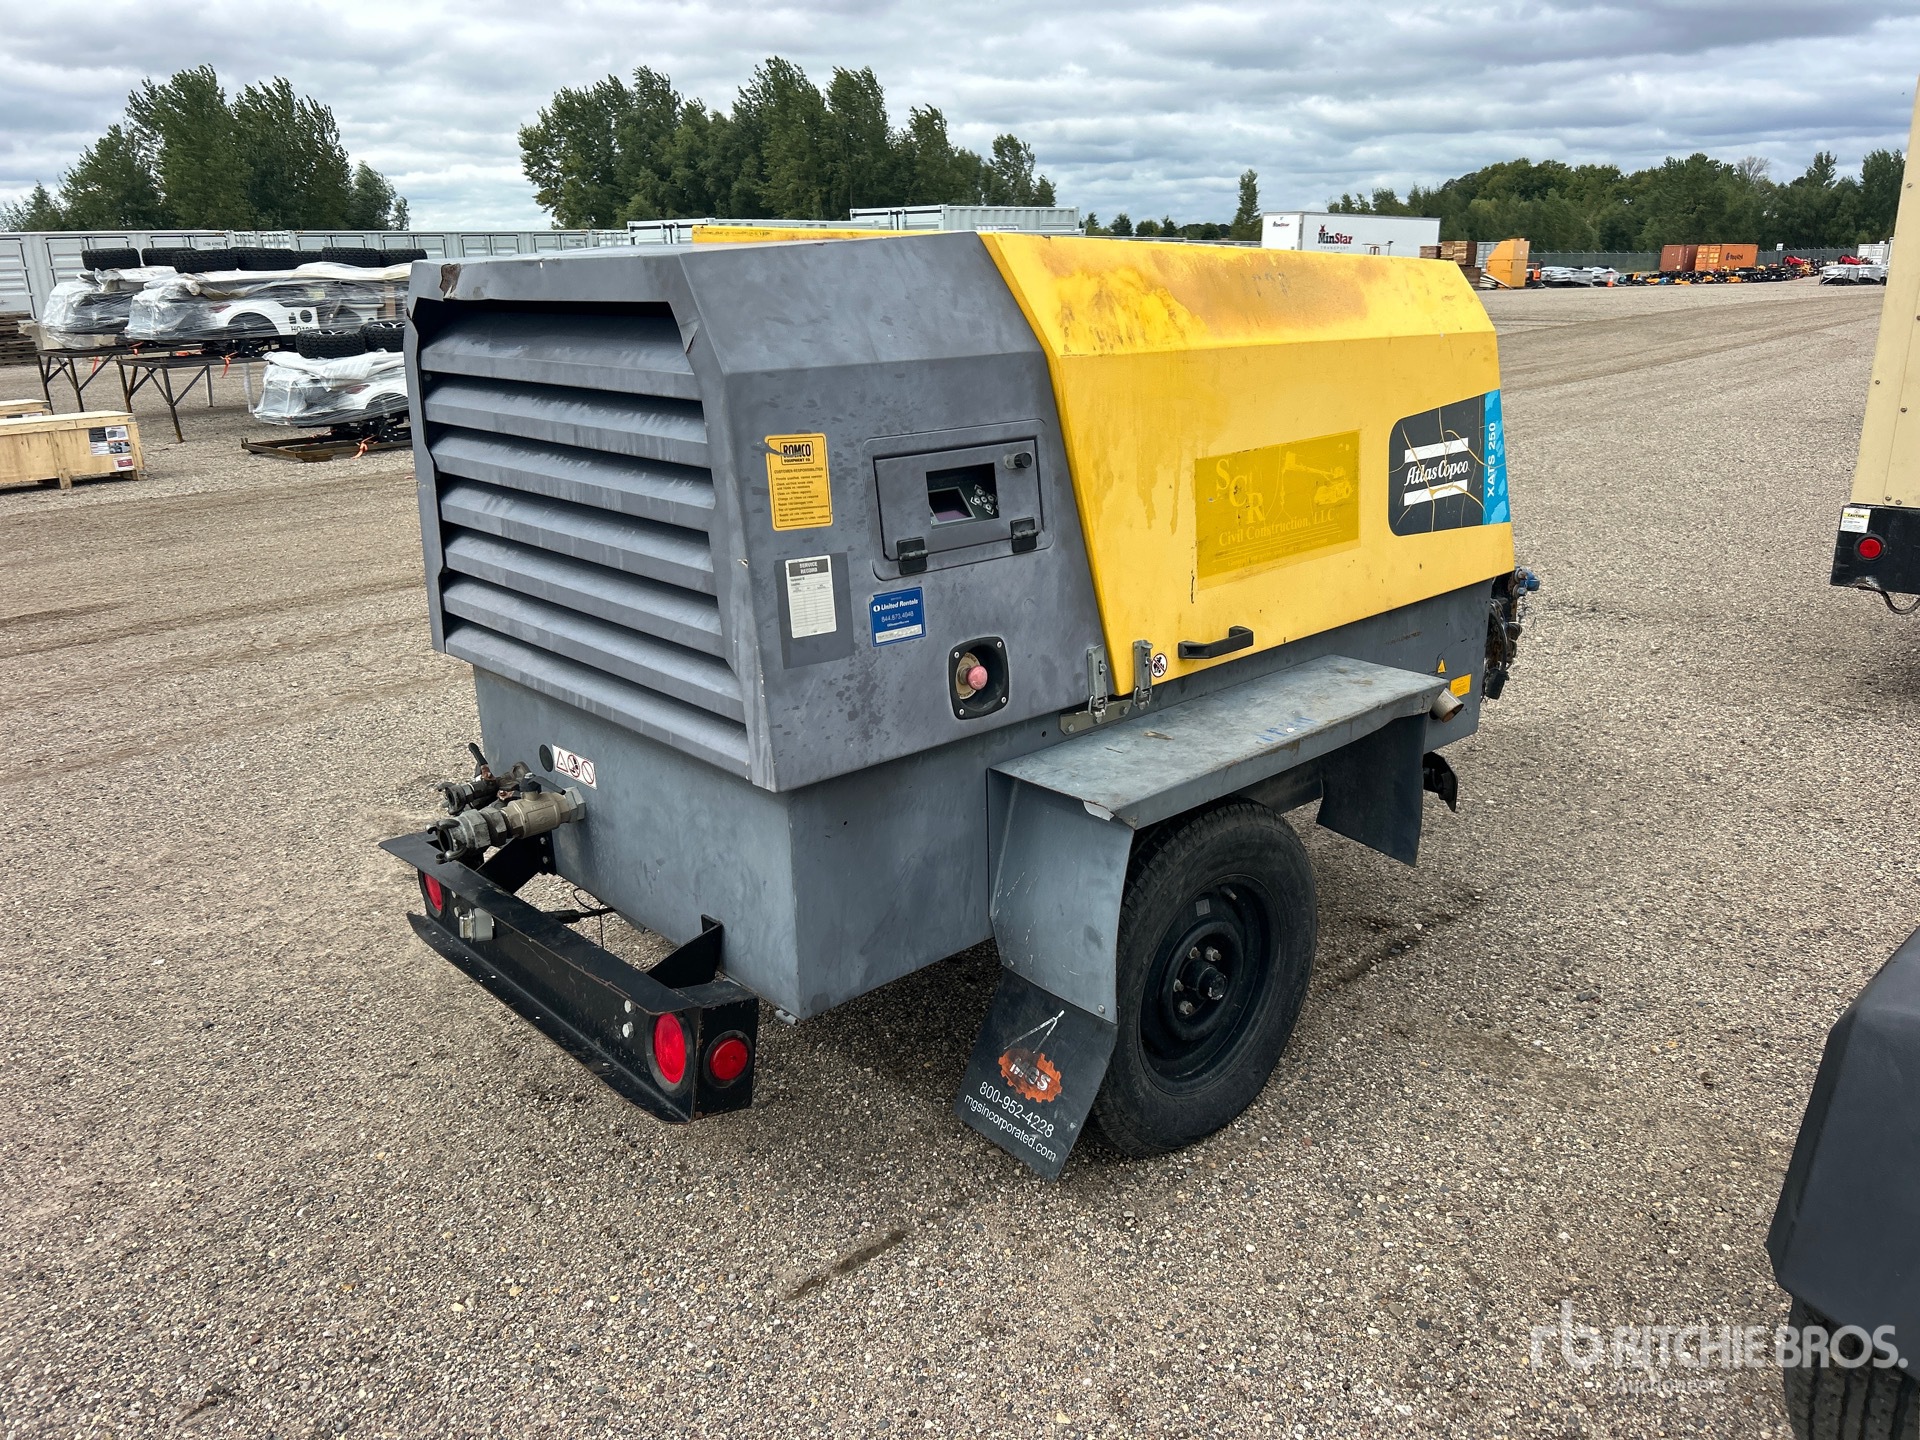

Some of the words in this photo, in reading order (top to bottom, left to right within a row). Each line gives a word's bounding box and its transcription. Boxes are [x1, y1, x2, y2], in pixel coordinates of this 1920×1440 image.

[1318, 232, 1353, 244] MinStar
[783, 444, 811, 458] ROMCO
[1488, 422, 1496, 451] 250
[1487, 454, 1496, 498] XATS
[1219, 529, 1243, 547] Civil
[1314, 508, 1335, 525] LLC
[881, 601, 899, 610] United
[899, 598, 919, 607] Rentals
[979, 1081, 1055, 1138] 800-952-4228
[964, 1094, 1057, 1162] mgsincorporated.com
